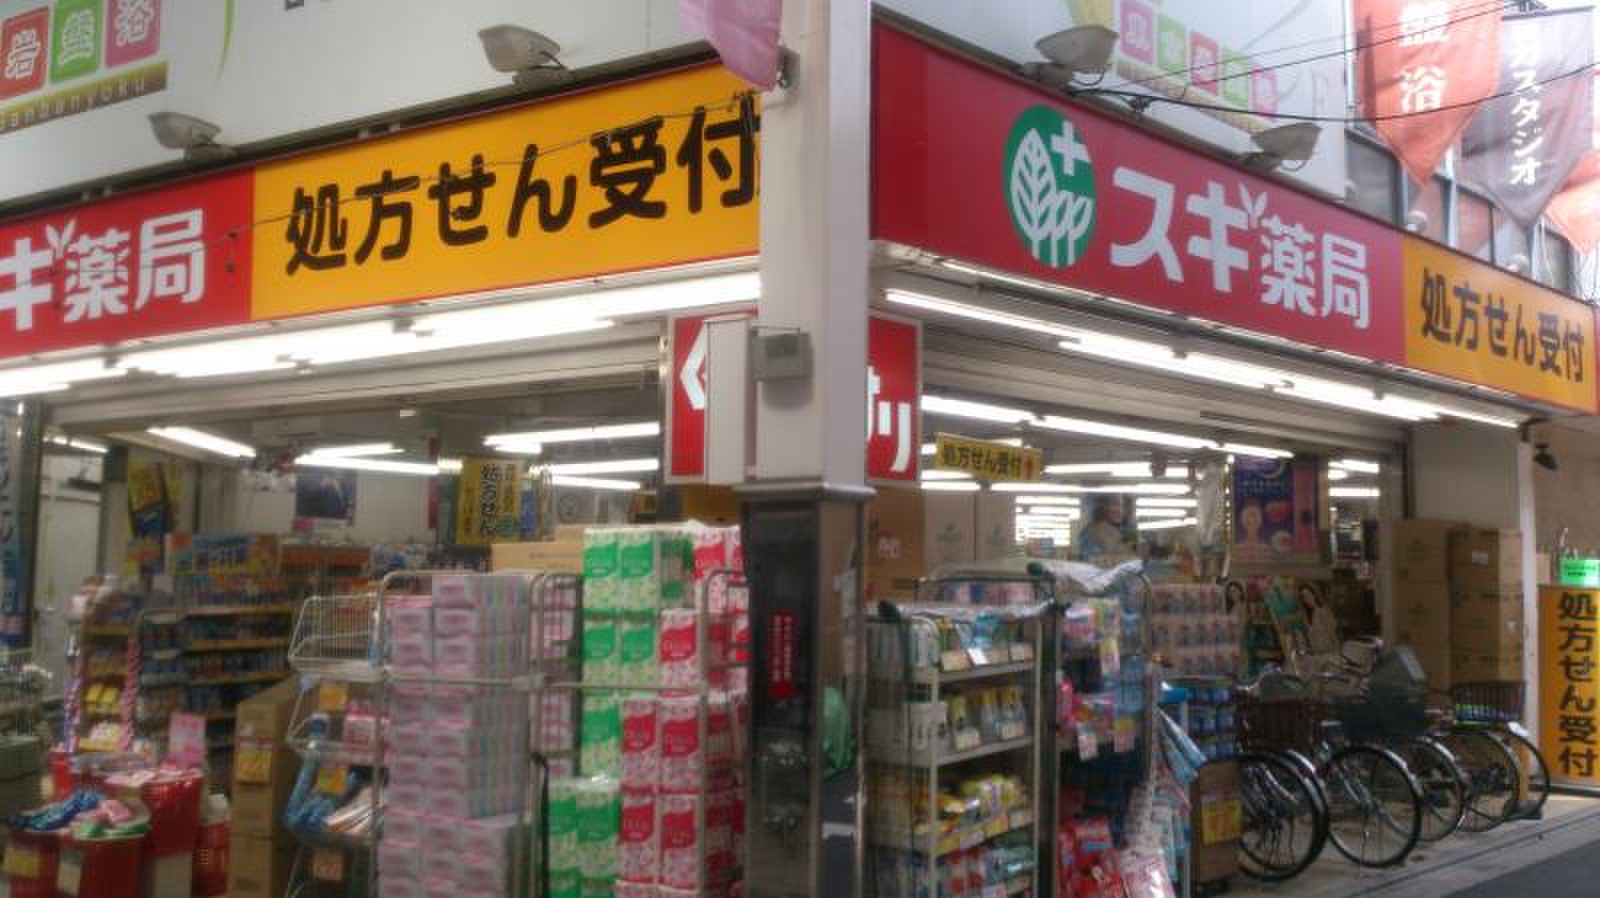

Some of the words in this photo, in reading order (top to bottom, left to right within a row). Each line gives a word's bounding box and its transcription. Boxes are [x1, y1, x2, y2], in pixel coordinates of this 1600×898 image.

[286, 85, 761, 276] 処方せん受付
[1109, 166, 1371, 331] スギ薬局
[1420, 267, 1585, 384] 処方せん受付
[1557, 591, 1598, 777] 処方せん受付
